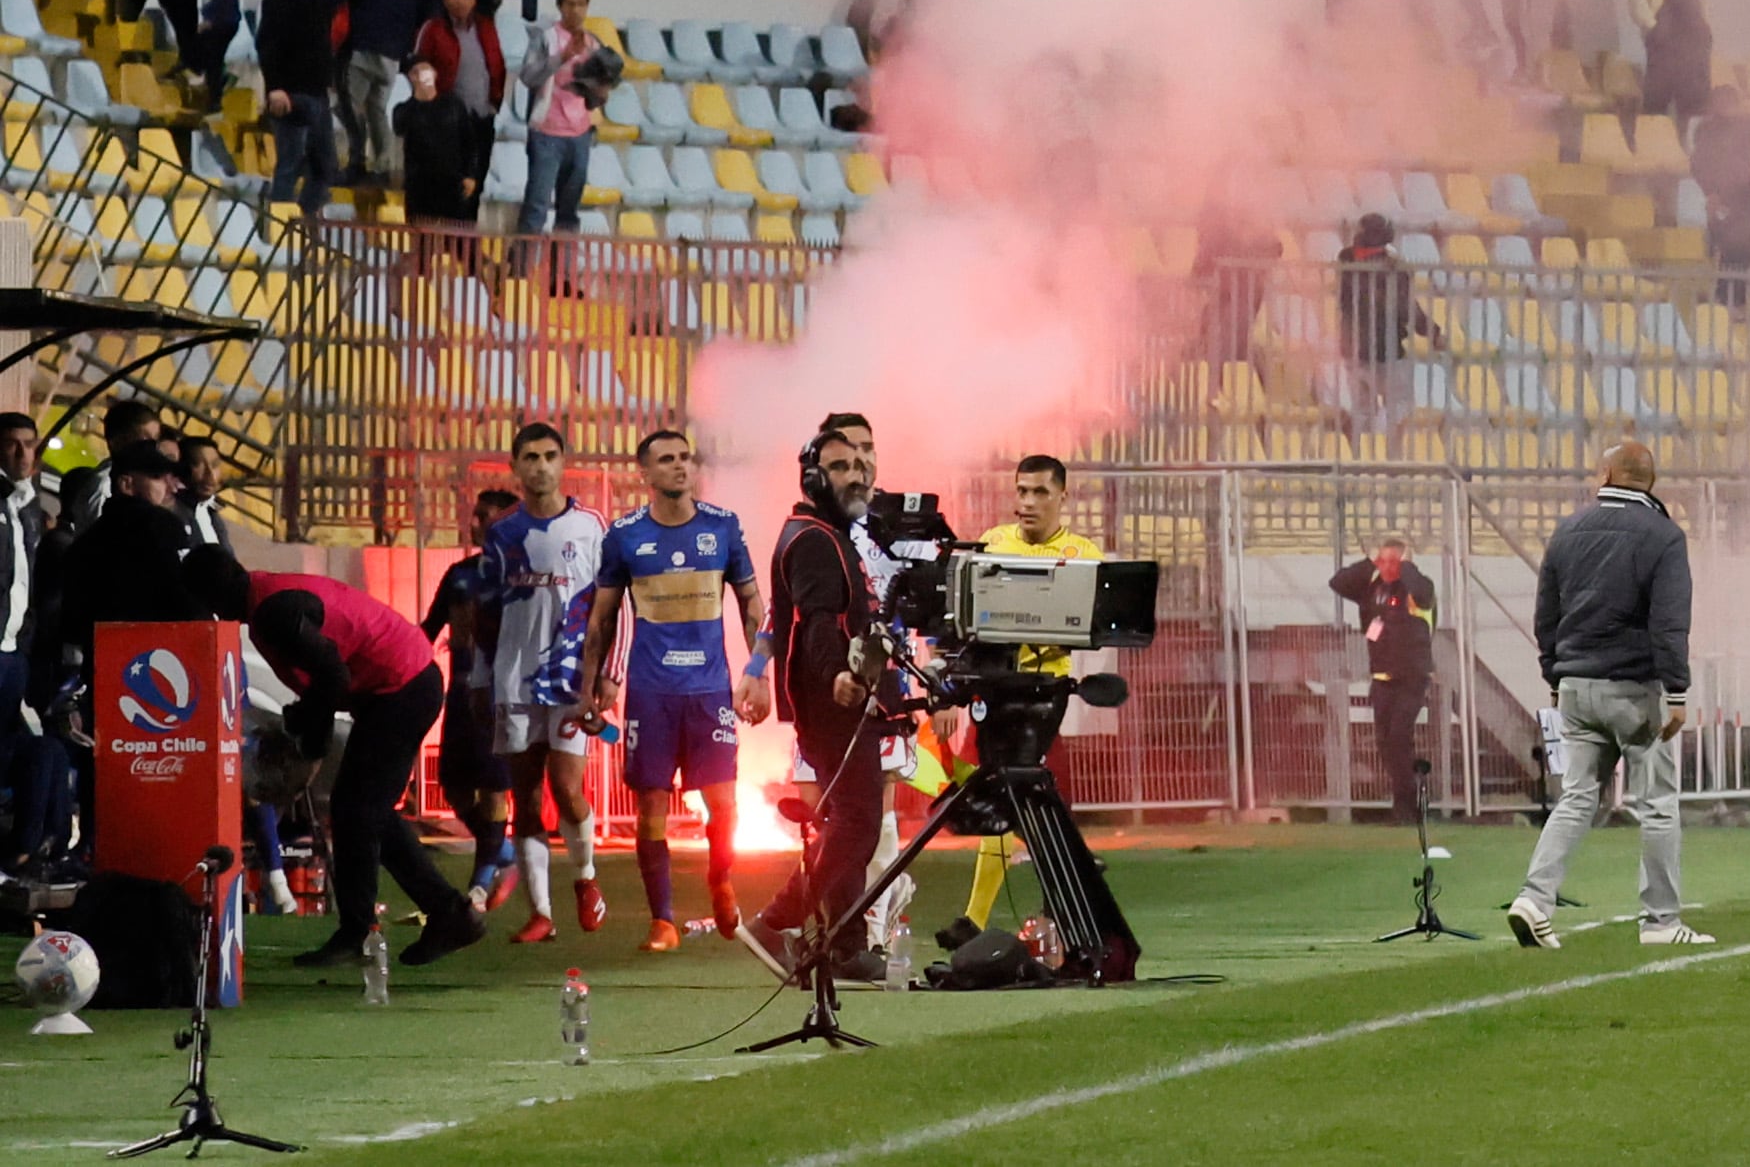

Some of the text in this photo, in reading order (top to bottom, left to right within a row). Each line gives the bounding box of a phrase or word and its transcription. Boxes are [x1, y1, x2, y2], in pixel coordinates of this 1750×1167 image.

[908, 498, 917, 511] 3
[625, 720, 639, 750] 5
[111, 738, 157, 754] Copa
[161, 737, 206, 752] Chile
